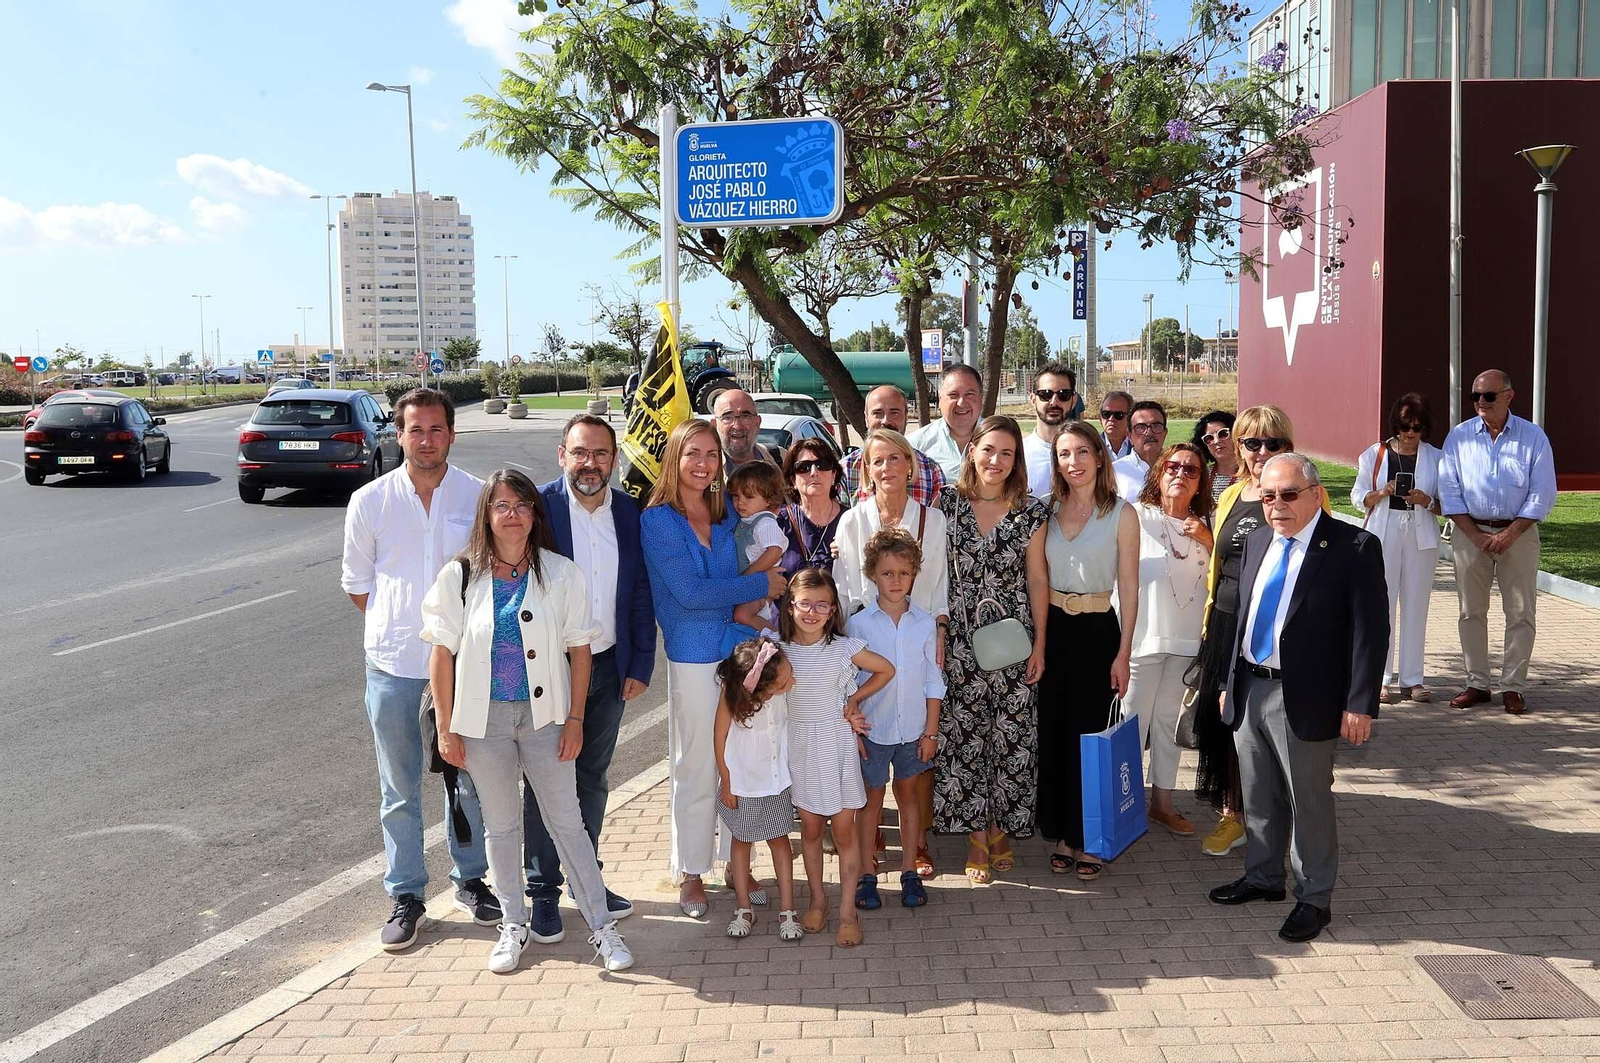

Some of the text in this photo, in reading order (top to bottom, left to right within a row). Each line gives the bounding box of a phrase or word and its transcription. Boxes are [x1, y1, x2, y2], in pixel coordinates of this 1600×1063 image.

[689, 153, 726, 161] GLORIETA
[688, 162, 767, 181] ARQUITECTO
[688, 180, 767, 200] JOSÉ PABLO
[688, 199, 797, 219] VÁZQUEZ HIERRO
[1327, 281, 1333, 301] LA
[1326, 304, 1333, 324] DE
[1332, 284, 1340, 324] Jesús
[1120, 797, 1134, 814] HUELVA
